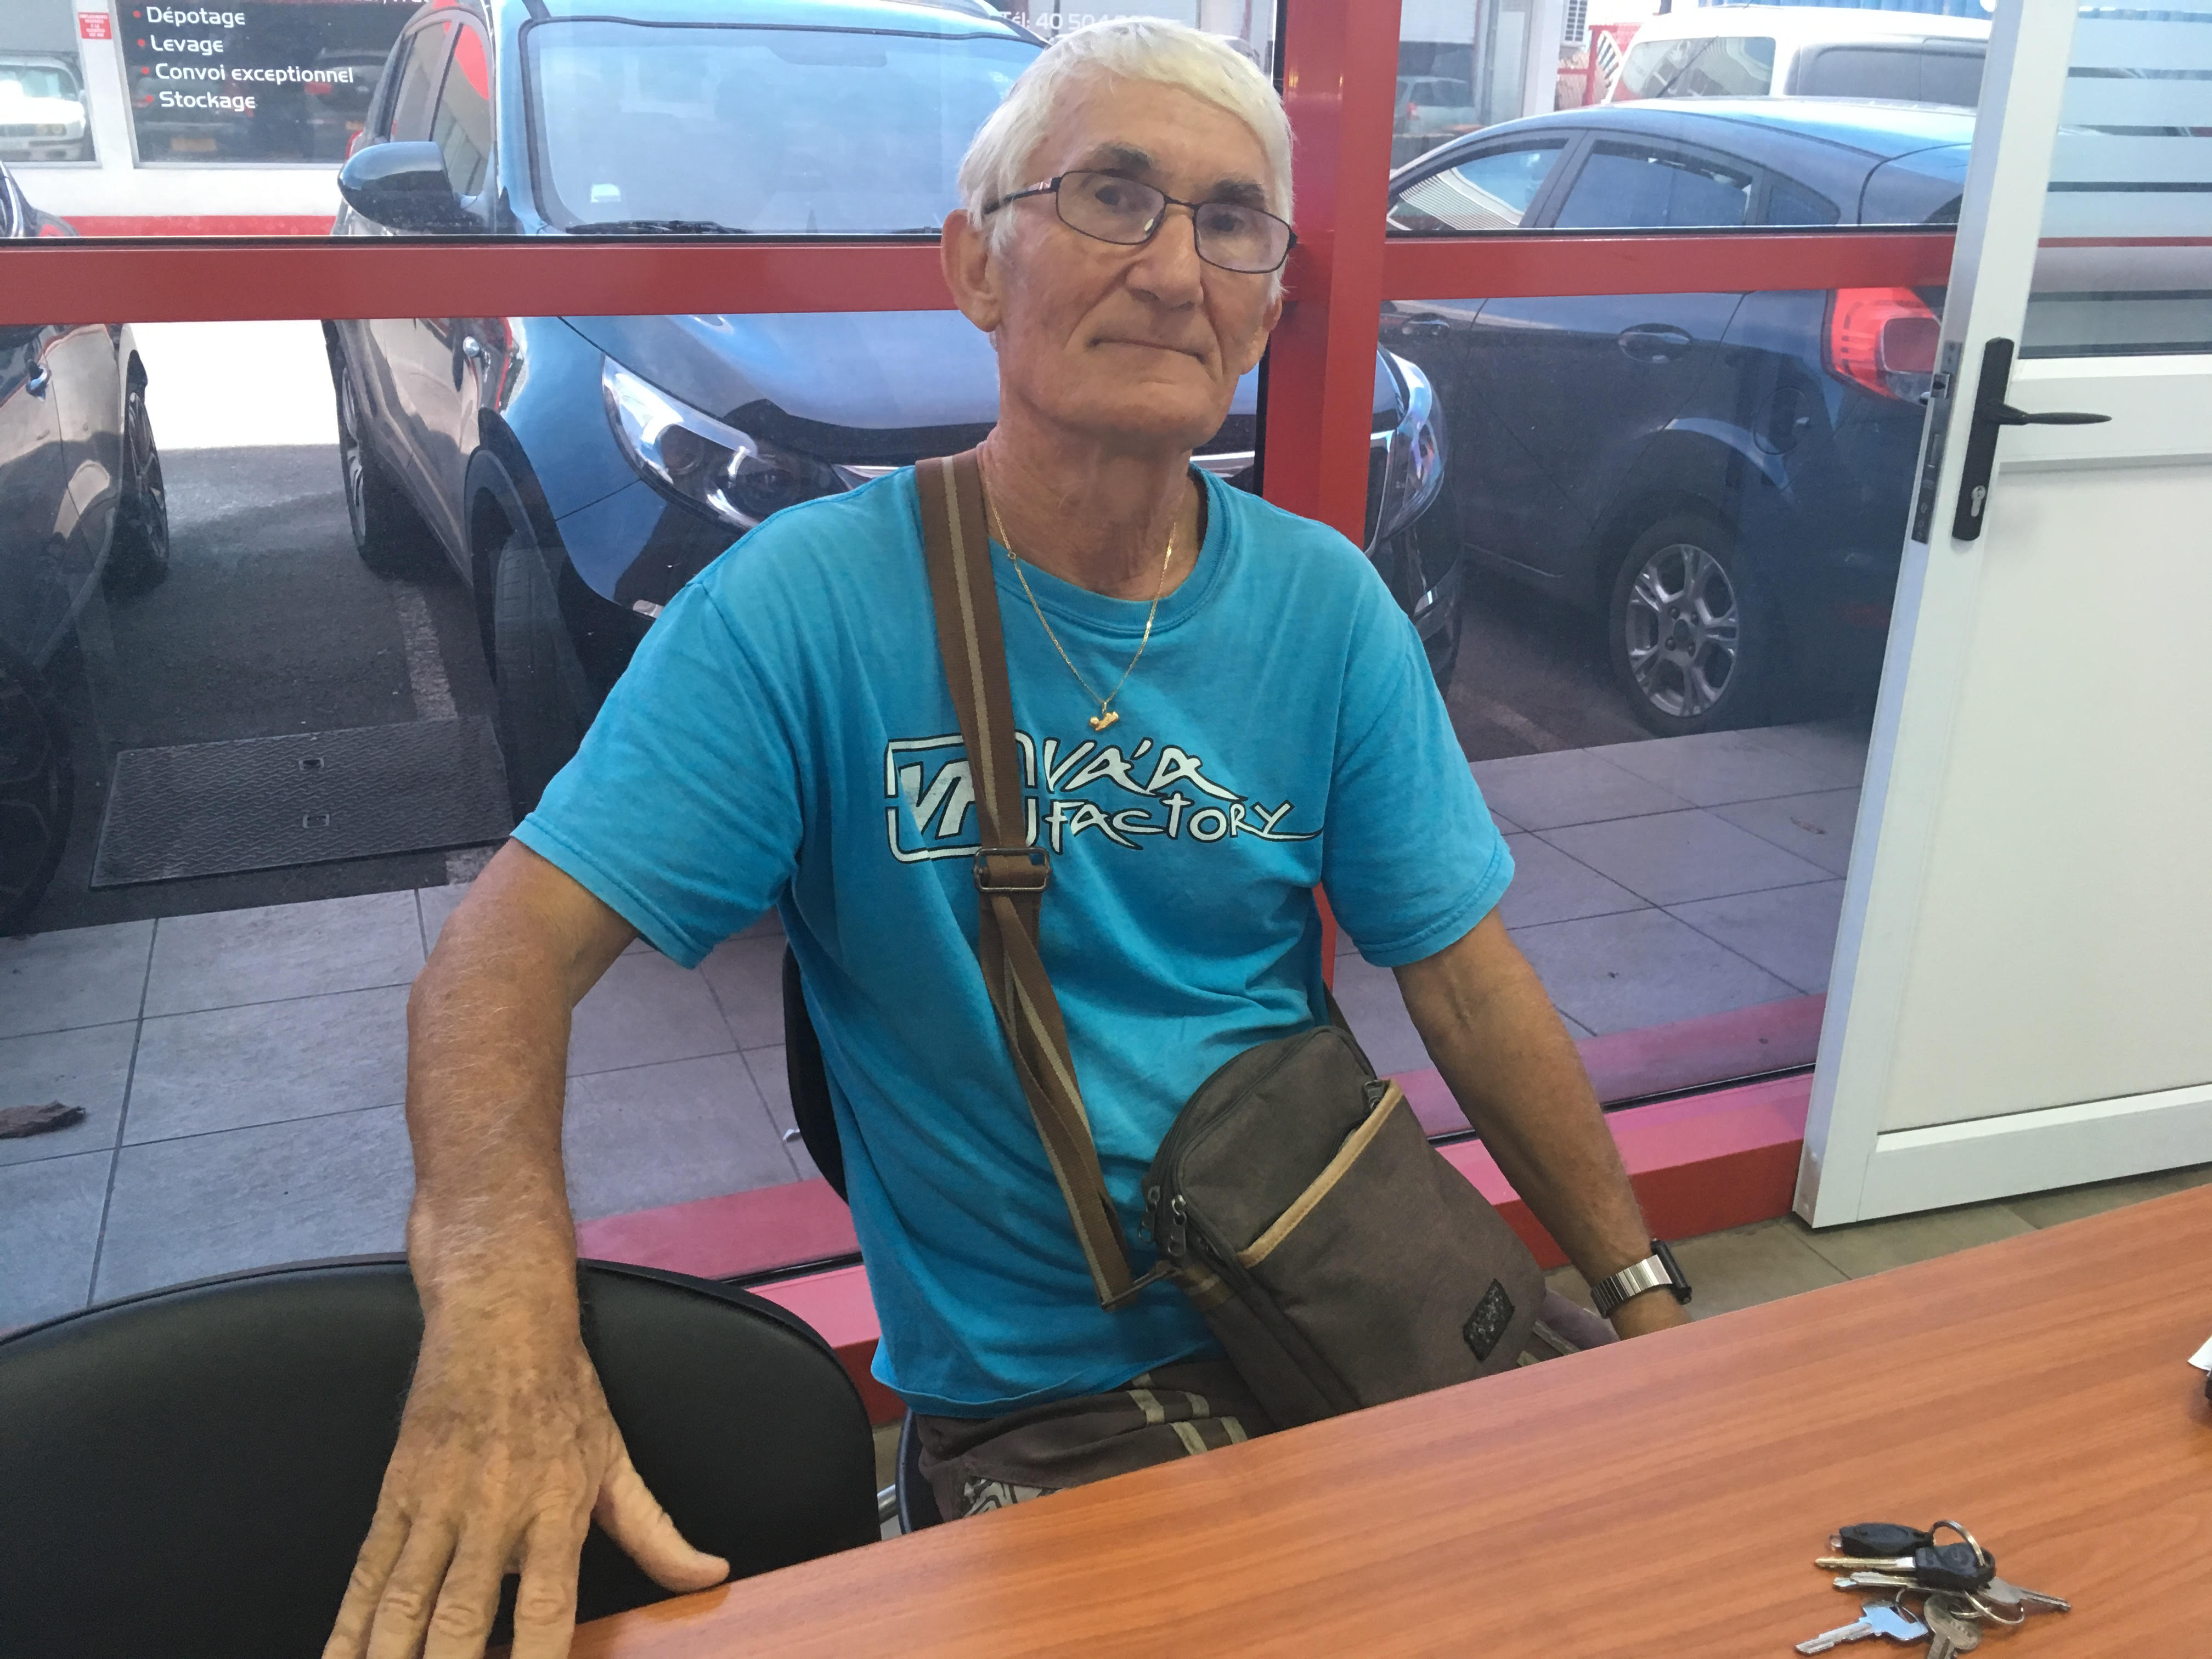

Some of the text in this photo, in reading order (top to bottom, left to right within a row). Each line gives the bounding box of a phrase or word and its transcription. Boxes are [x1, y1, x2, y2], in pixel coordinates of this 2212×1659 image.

[146, 6, 246, 28] Dépotage
[1035, 13, 1064, 30] 40
[150, 35, 224, 55] Levage
[155, 63, 354, 84] Convoi exceptionnel
[159, 91, 256, 111] Stockage
